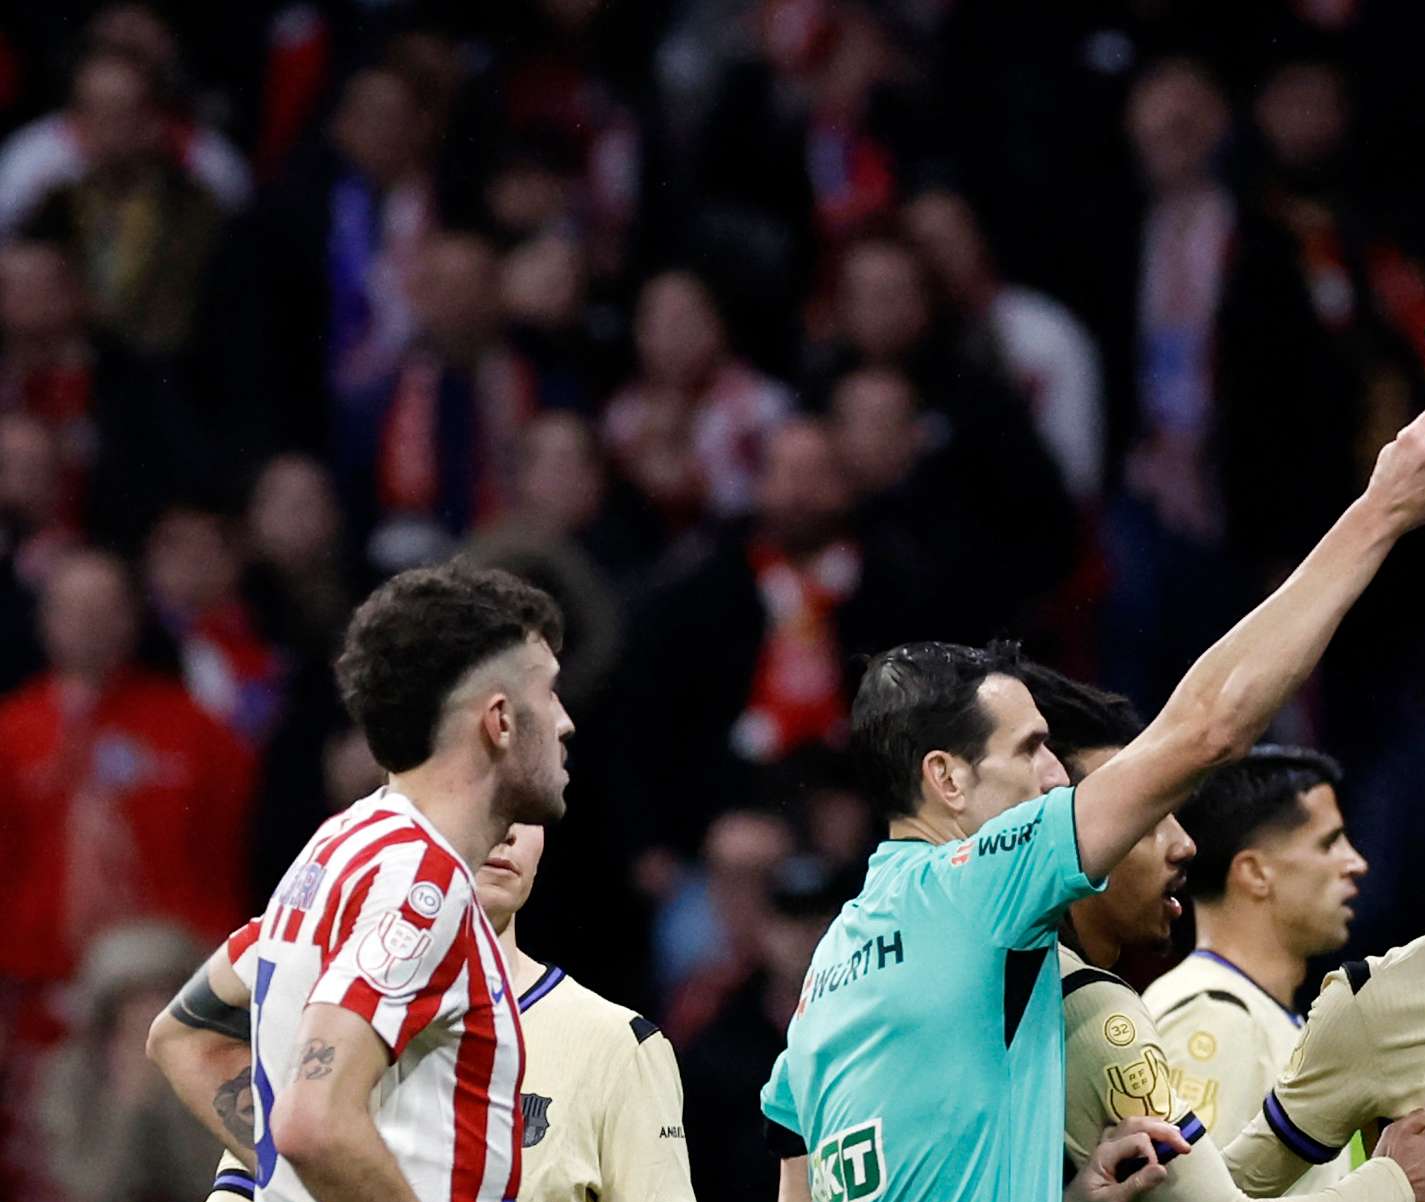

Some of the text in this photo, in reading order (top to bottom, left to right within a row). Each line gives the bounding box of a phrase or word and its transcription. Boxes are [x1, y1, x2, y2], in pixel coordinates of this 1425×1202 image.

[416, 890, 437, 908] 10
[810, 930, 904, 1003] WÜRTH
[1111, 1023, 1130, 1037] 32
